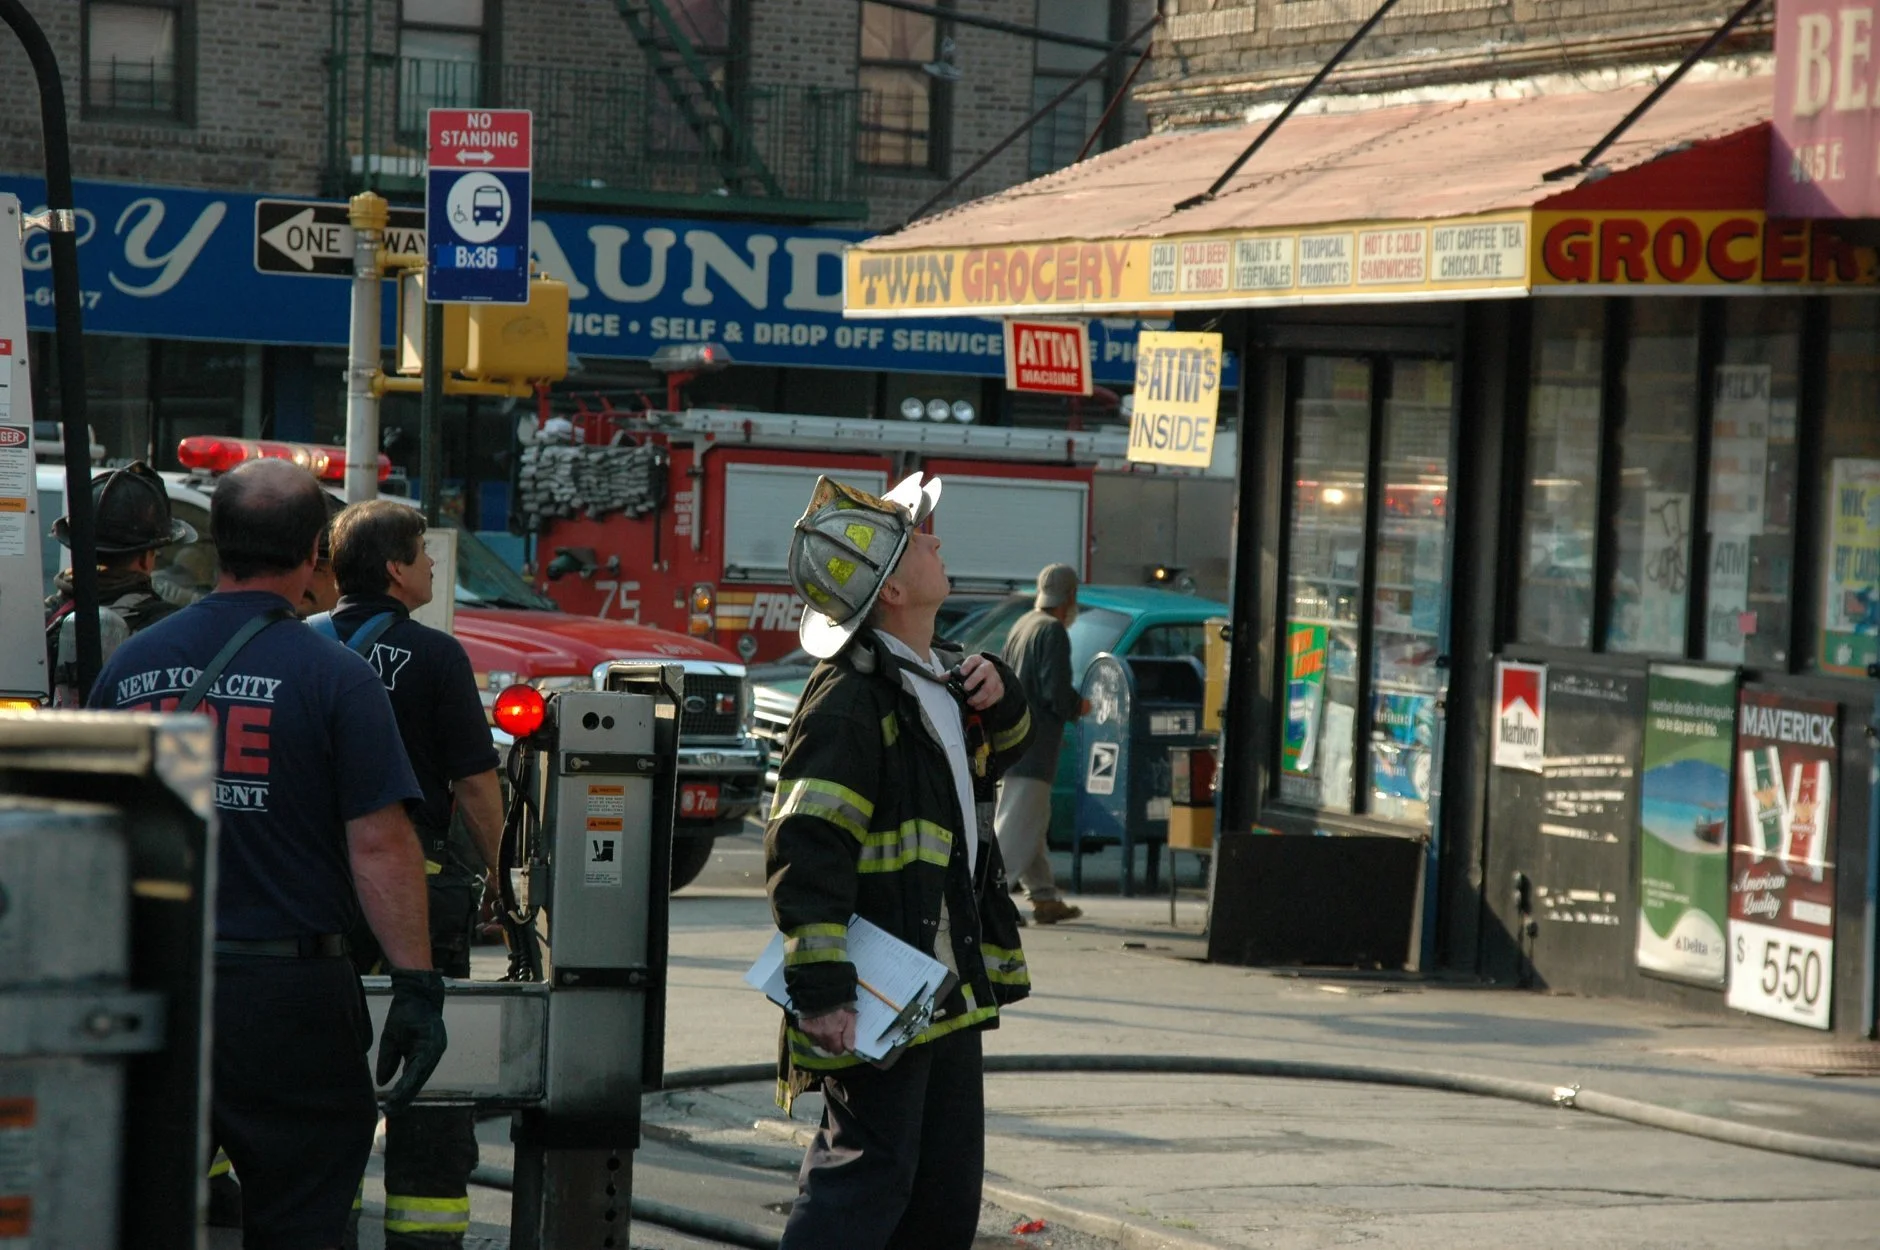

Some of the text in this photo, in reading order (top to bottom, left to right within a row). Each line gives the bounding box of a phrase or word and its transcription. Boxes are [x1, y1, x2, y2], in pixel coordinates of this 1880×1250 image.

[1794, 8, 1880, 118] BE
[467, 113, 492, 128] NO
[440, 131, 518, 147] STANDING
[287, 226, 340, 253] ONE
[1302, 237, 1346, 260] TROPICAL
[1364, 233, 1383, 256] HOT
[1396, 231, 1422, 254] COLD
[1435, 225, 1522, 252] HOT COFFEE TEA
[455, 246, 498, 269] Bx36
[1153, 246, 1176, 267] COLD
[1183, 243, 1229, 265] COLD BEER
[1239, 241, 1271, 263] FRUITS
[531, 220, 845, 312] AUND
[860, 243, 1131, 305] TWIN GROCERY
[1236, 264, 1291, 288] VEGETABLES
[1300, 262, 1349, 285] PRODUCTS
[1360, 257, 1423, 280] SANDWICHES
[1441, 253, 1502, 277] CHOCOLATE
[1152, 271, 1175, 291] CUTS
[1196, 268, 1224, 289] SODAS
[650, 317, 717, 340] SELF
[723, 320, 743, 342] &
[754, 323, 828, 346] DROP
[835, 326, 884, 349] OFF
[892, 329, 1003, 356] SERVICE
[1104, 340, 1138, 364] PI
[1018, 329, 1080, 370] ATM
[1021, 369, 1079, 388] MACHINE
[1132, 412, 1211, 453] INSIDE
[595, 581, 641, 625] 75
[747, 592, 805, 632] FIRE
[117, 666, 281, 701] NEW YOK CITY
[1740, 704, 1835, 747] MAVERICK
[1733, 870, 1786, 892] American
[1743, 891, 1782, 920] Quality
[1737, 935, 1745, 965] $
